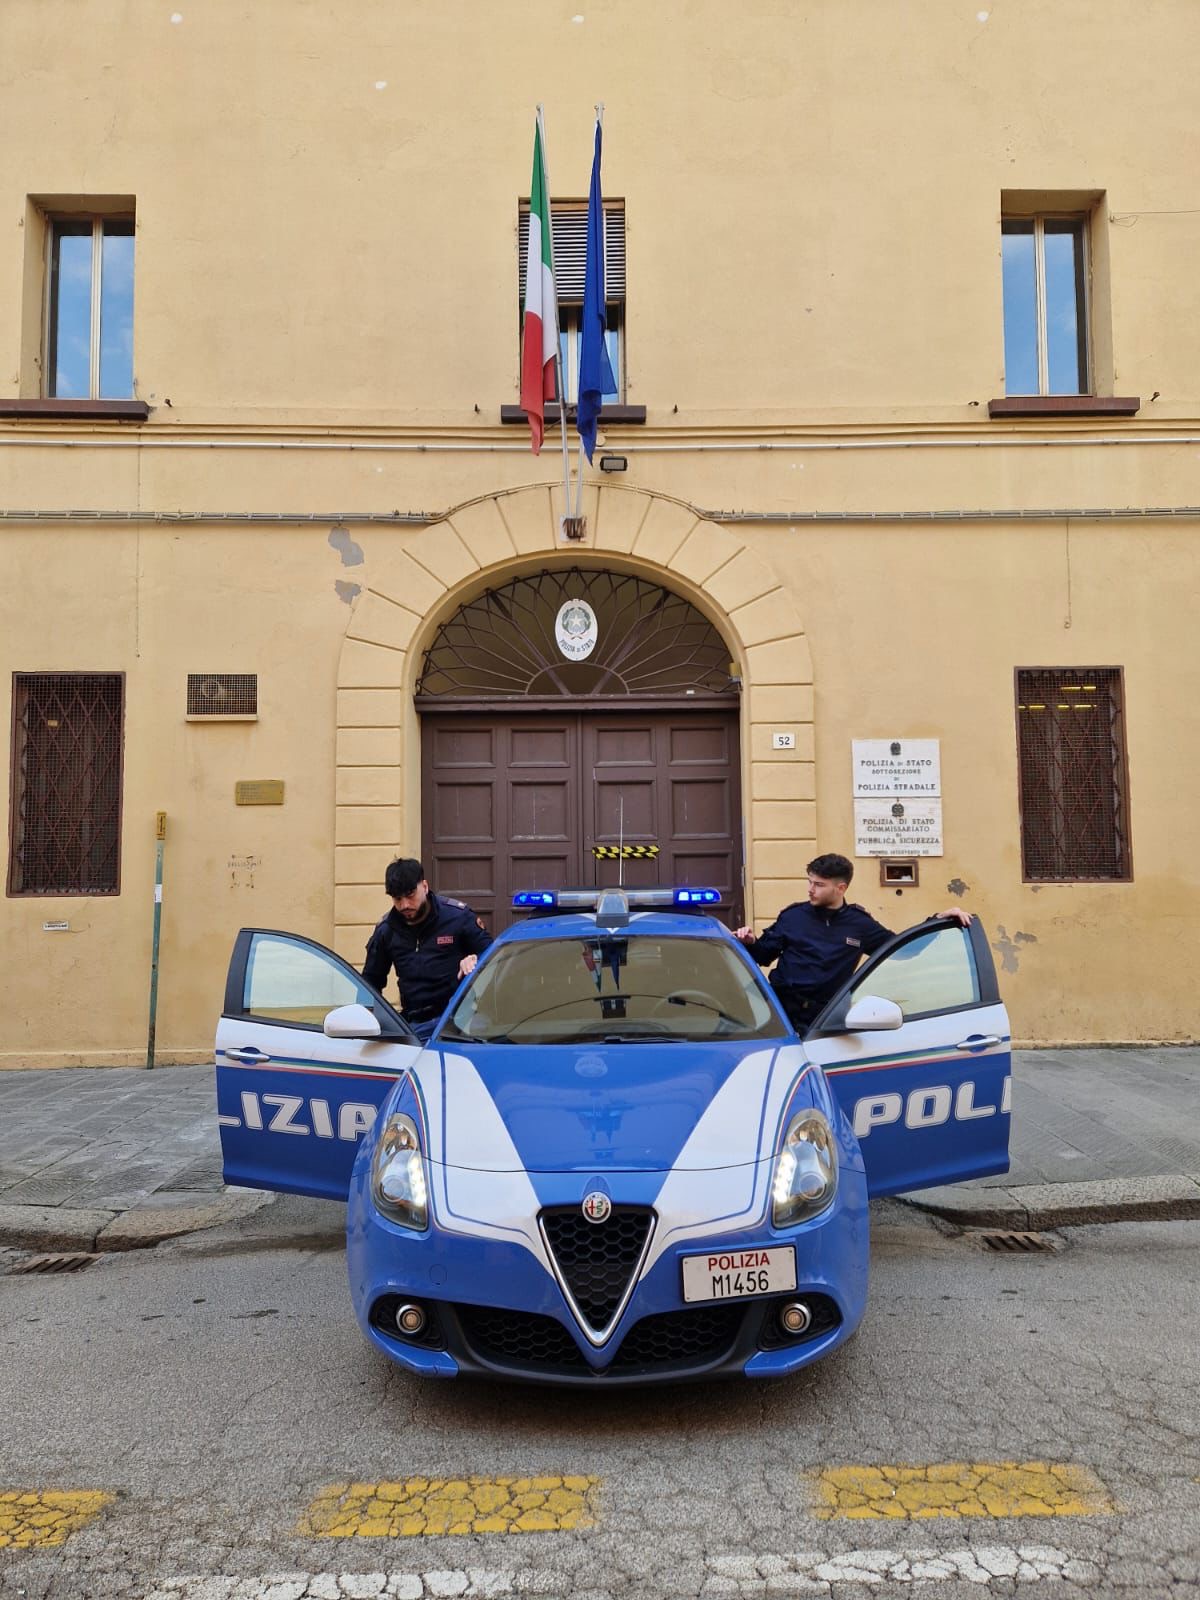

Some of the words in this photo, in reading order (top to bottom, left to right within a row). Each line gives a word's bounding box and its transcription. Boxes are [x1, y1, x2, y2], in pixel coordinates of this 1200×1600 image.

[778, 736, 790, 746] 52
[906, 759, 932, 767] STATO
[857, 783, 890, 791] POLIZIA
[893, 783, 936, 791] STRADALE
[866, 825, 930, 833] COMMISSARIATO
[857, 837, 896, 845] PUBBLICA
[708, 1252, 770, 1272] POLIZIA
[712, 1270, 769, 1297] M1456
